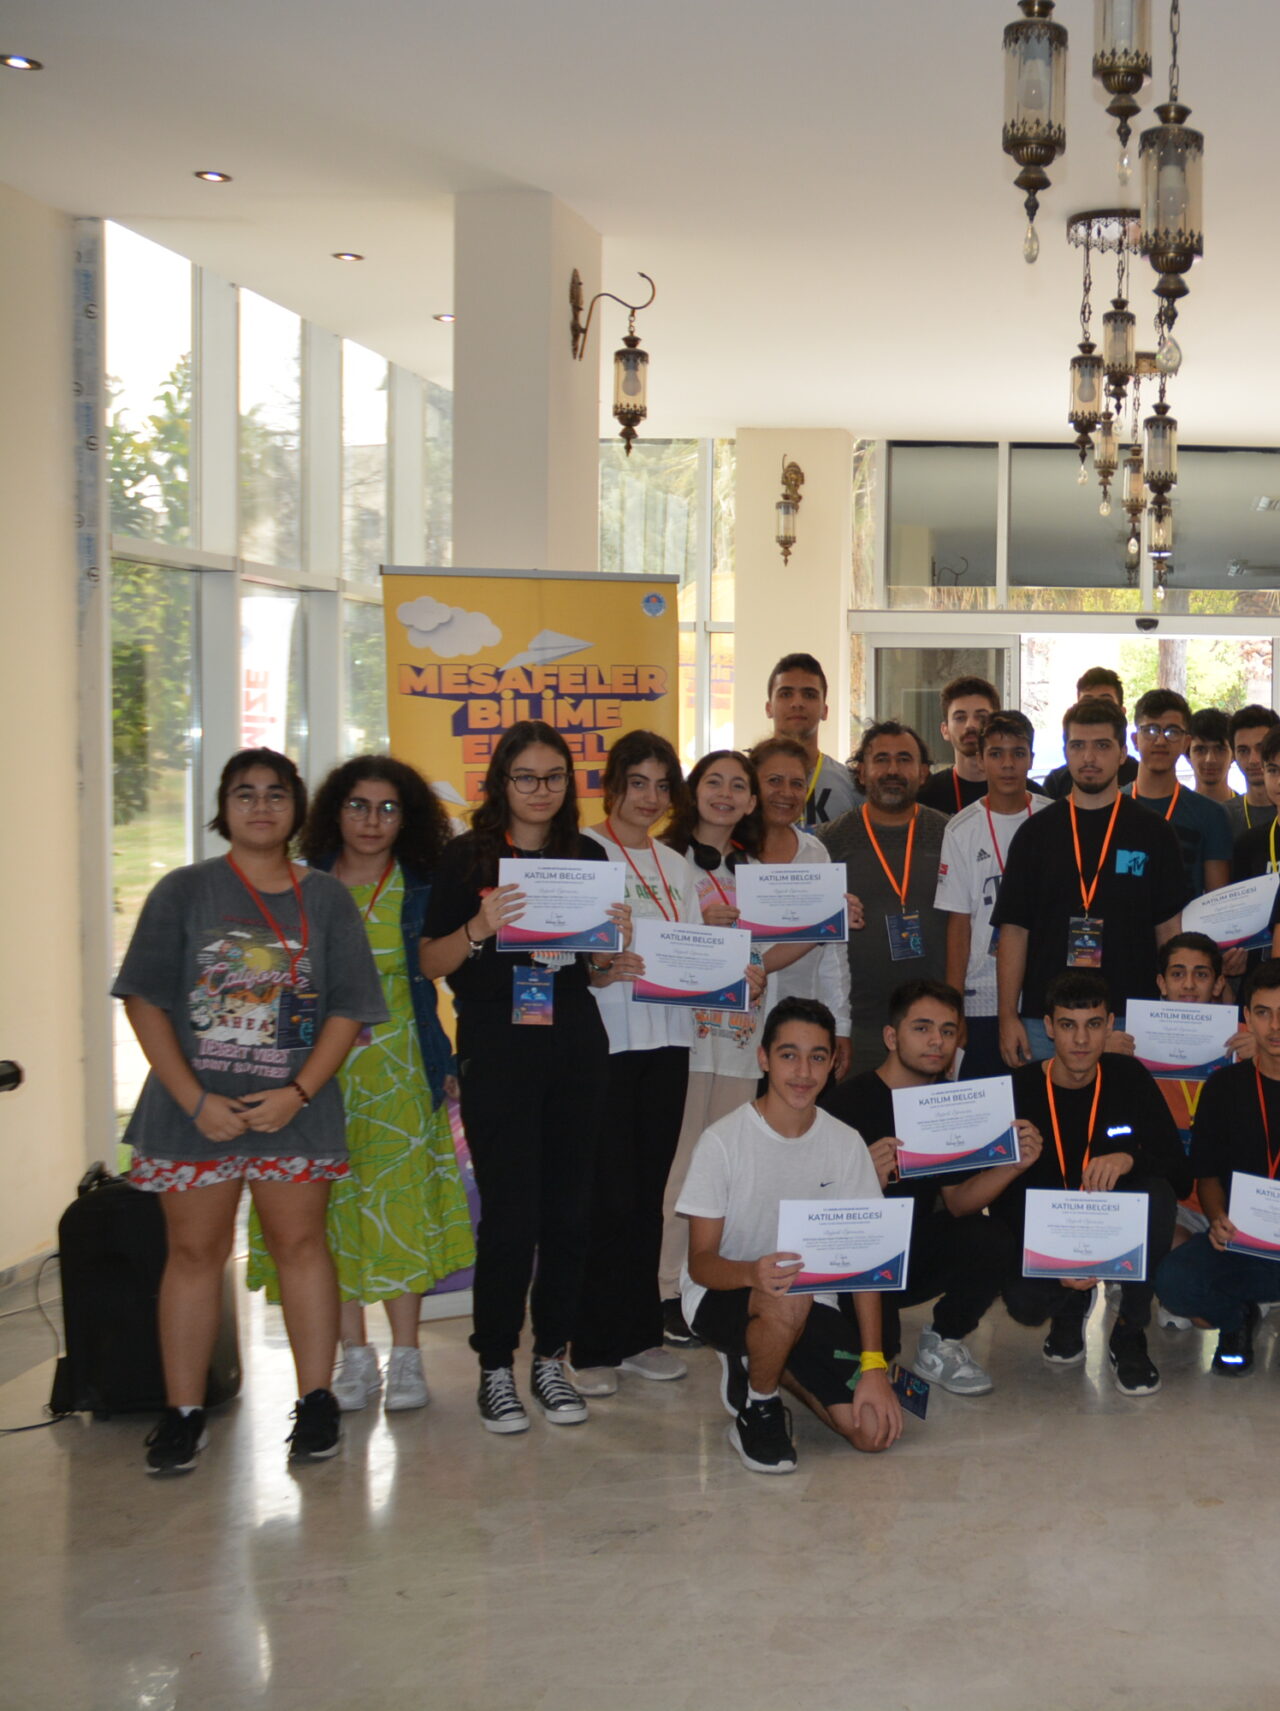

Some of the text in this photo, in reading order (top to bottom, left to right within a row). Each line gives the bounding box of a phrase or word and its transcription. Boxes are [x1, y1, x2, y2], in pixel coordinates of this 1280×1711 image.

[398, 664, 668, 698] MESAFELER
[465, 690, 622, 729] BİLİME
[463, 733, 610, 764] EEL
[524, 872, 557, 880] KATILIM
[660, 933, 691, 942] KATILIM
[202, 962, 311, 997] Californa
[1150, 1012, 1179, 1020] KATILIM
[919, 1096, 951, 1105] KATILIM
[808, 1210, 882, 1221] KATILIM BELGESİ
